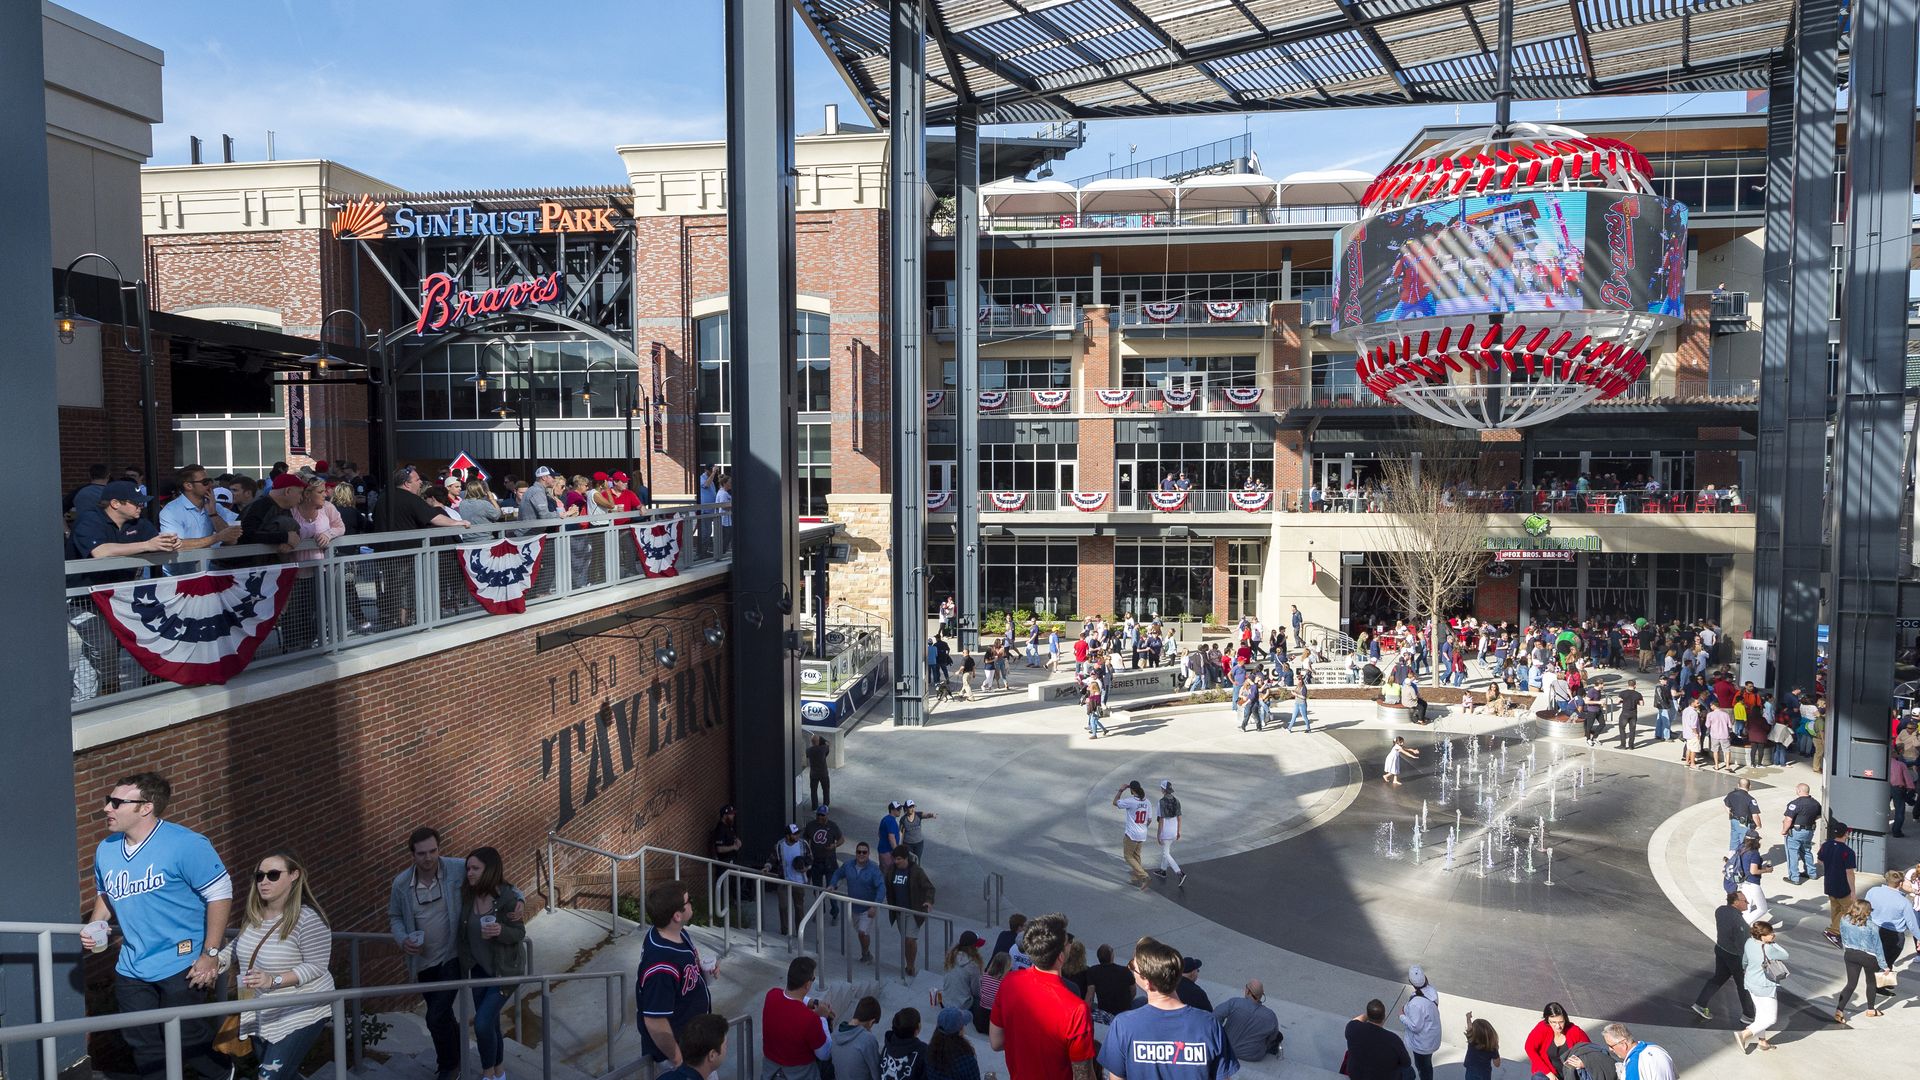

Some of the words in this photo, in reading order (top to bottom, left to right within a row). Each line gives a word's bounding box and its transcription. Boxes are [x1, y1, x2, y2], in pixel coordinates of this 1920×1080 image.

[540, 202, 616, 234] PARK
[1599, 213, 1635, 310] Braves
[416, 271, 563, 337] Braves
[1538, 535, 1601, 551] TAPROOM
[803, 671, 817, 679] FOX
[1110, 679, 1134, 689] SERIES
[1136, 676, 1160, 687] TITLES
[807, 705, 824, 713] FOX
[541, 653, 726, 832] TAVERN
[1135, 810, 1147, 825] 10
[104, 863, 166, 901] Atlanta
[1136, 1044, 1175, 1061] CHOP
[1183, 1045, 1204, 1062] ON
